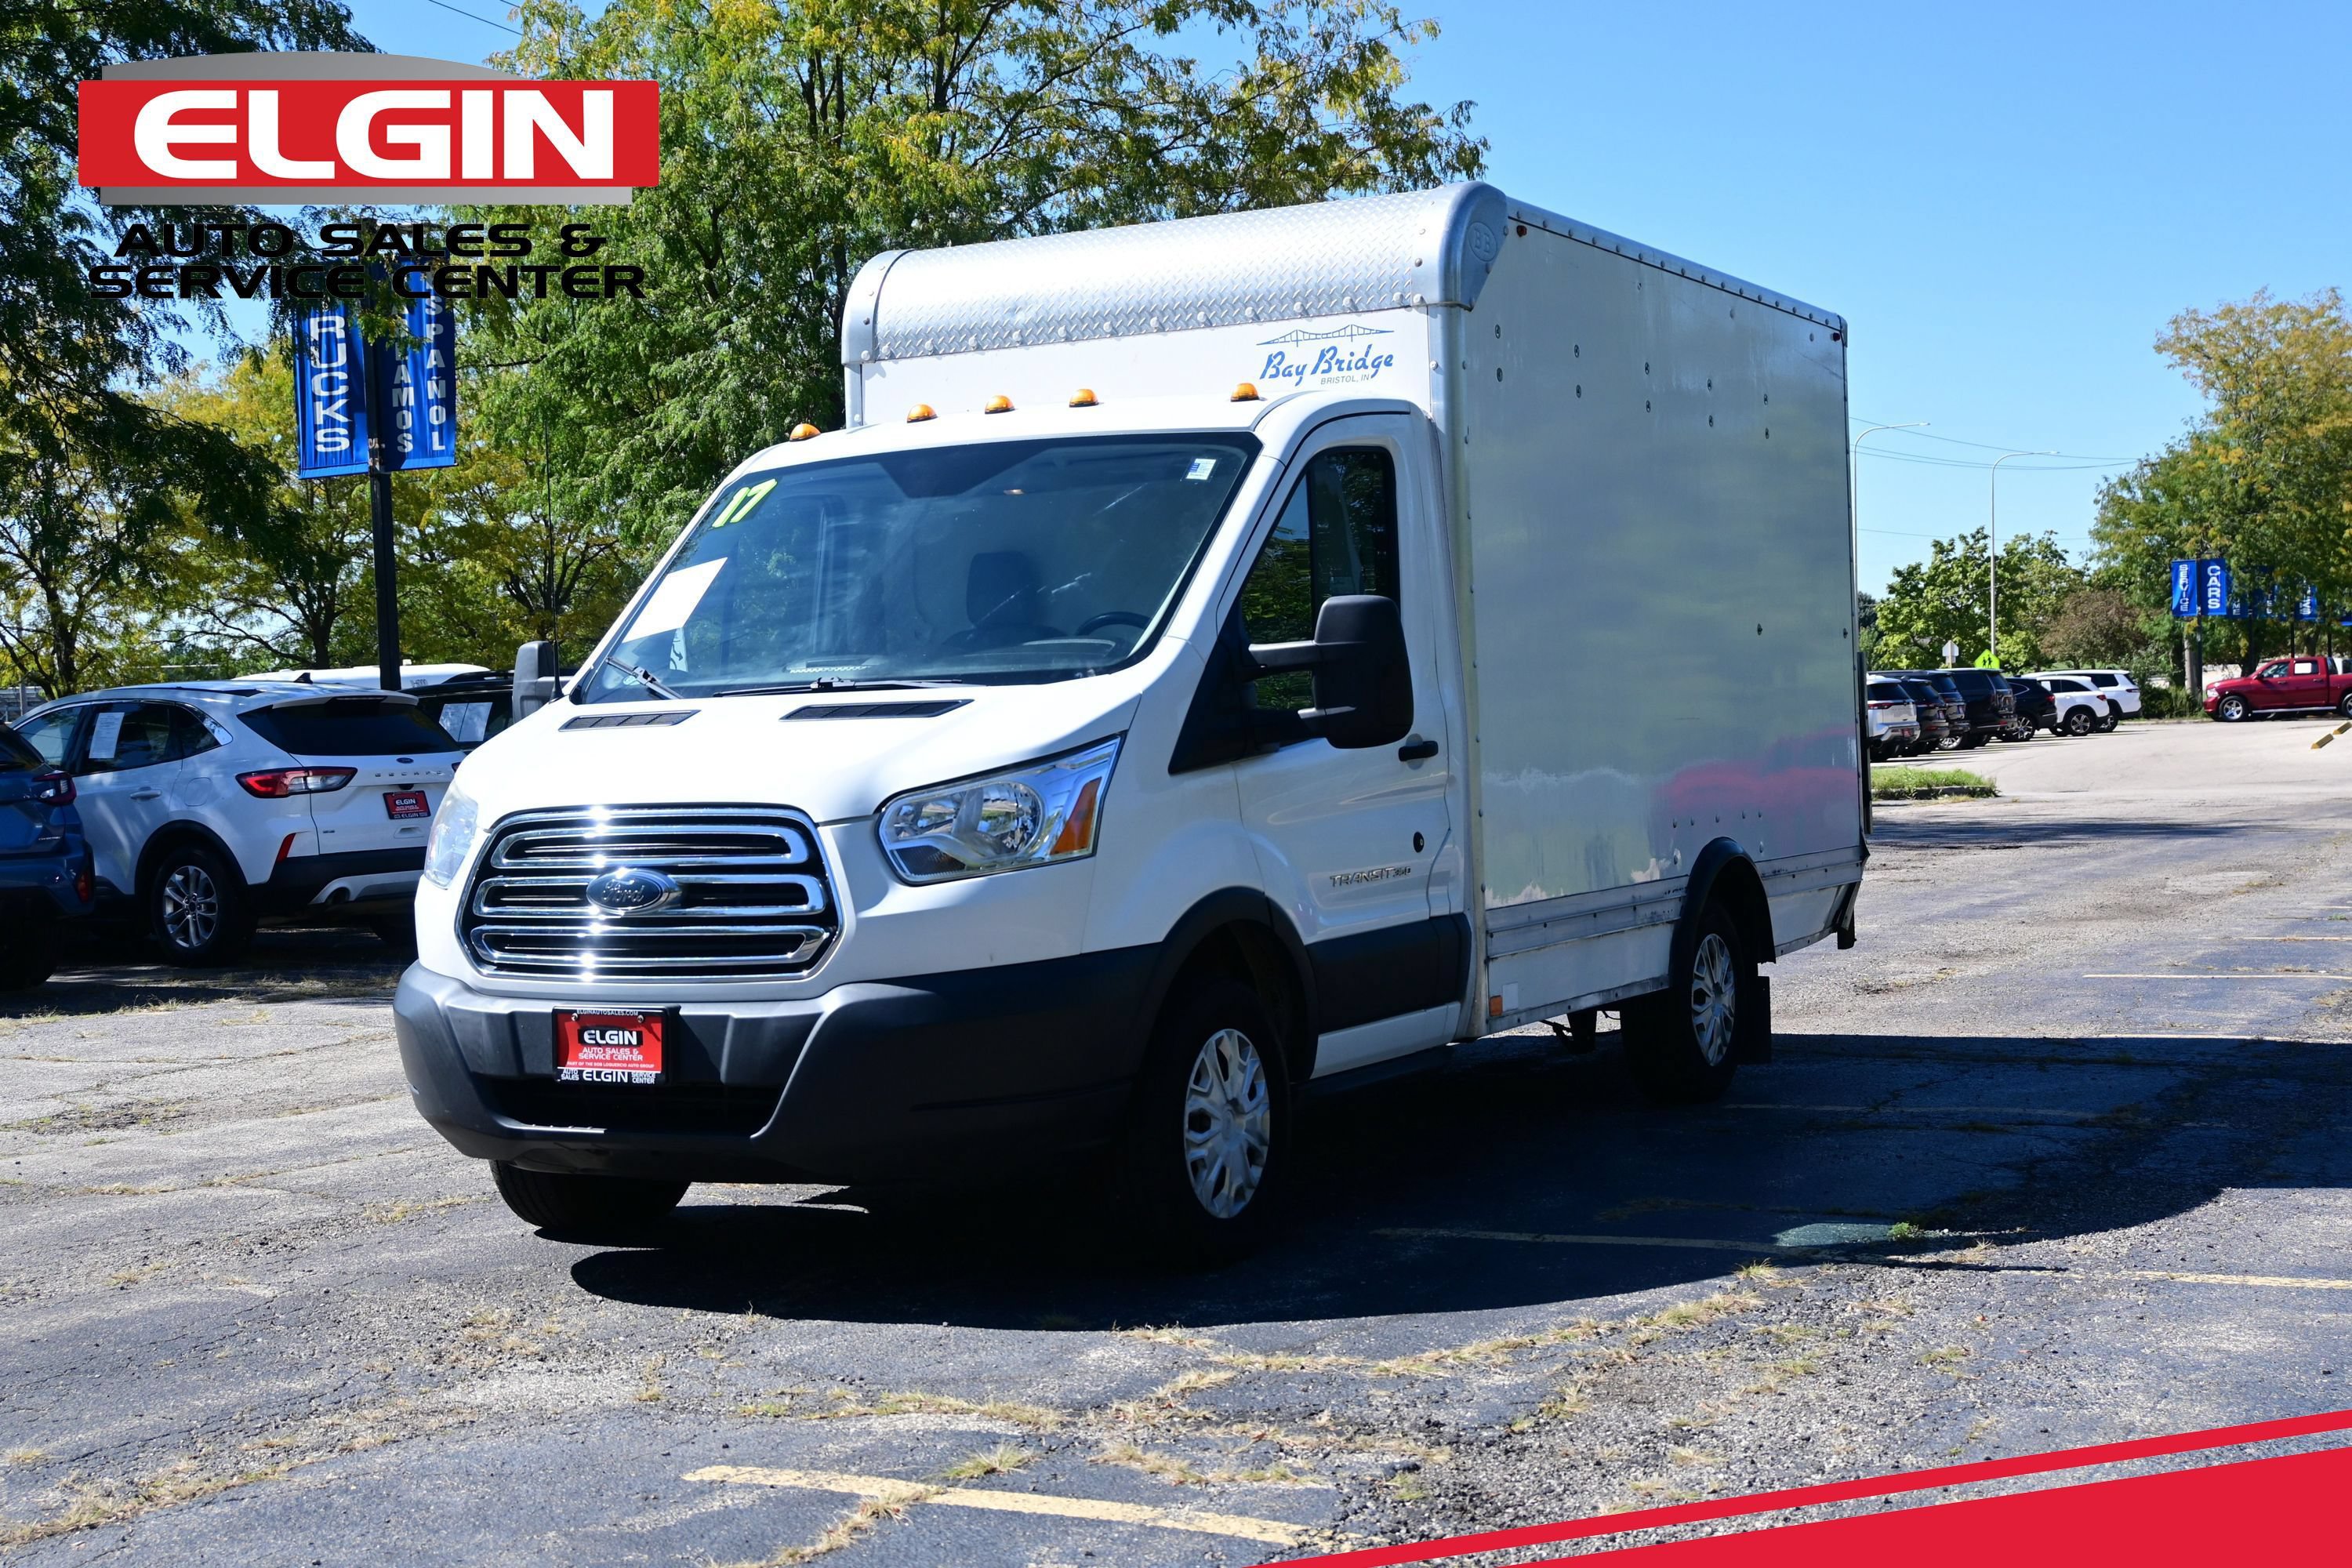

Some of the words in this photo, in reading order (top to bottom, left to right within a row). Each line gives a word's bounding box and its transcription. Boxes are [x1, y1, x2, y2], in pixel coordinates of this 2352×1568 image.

[1260, 350, 1308, 387] Bay
[1311, 343, 1393, 379] Bridge
[1320, 375, 1359, 385] BRISTOL,
[310, 314, 352, 452] RUCKS
[712, 478, 778, 528] 17
[2179, 564, 2189, 612] SERVICE
[2207, 565, 2221, 609] CARS
[602, 879, 644, 902] Ford
[1330, 867, 1394, 887] TRANSIT
[583, 1029, 637, 1045] ELGIN
[583, 1069, 628, 1083] ELGIN
